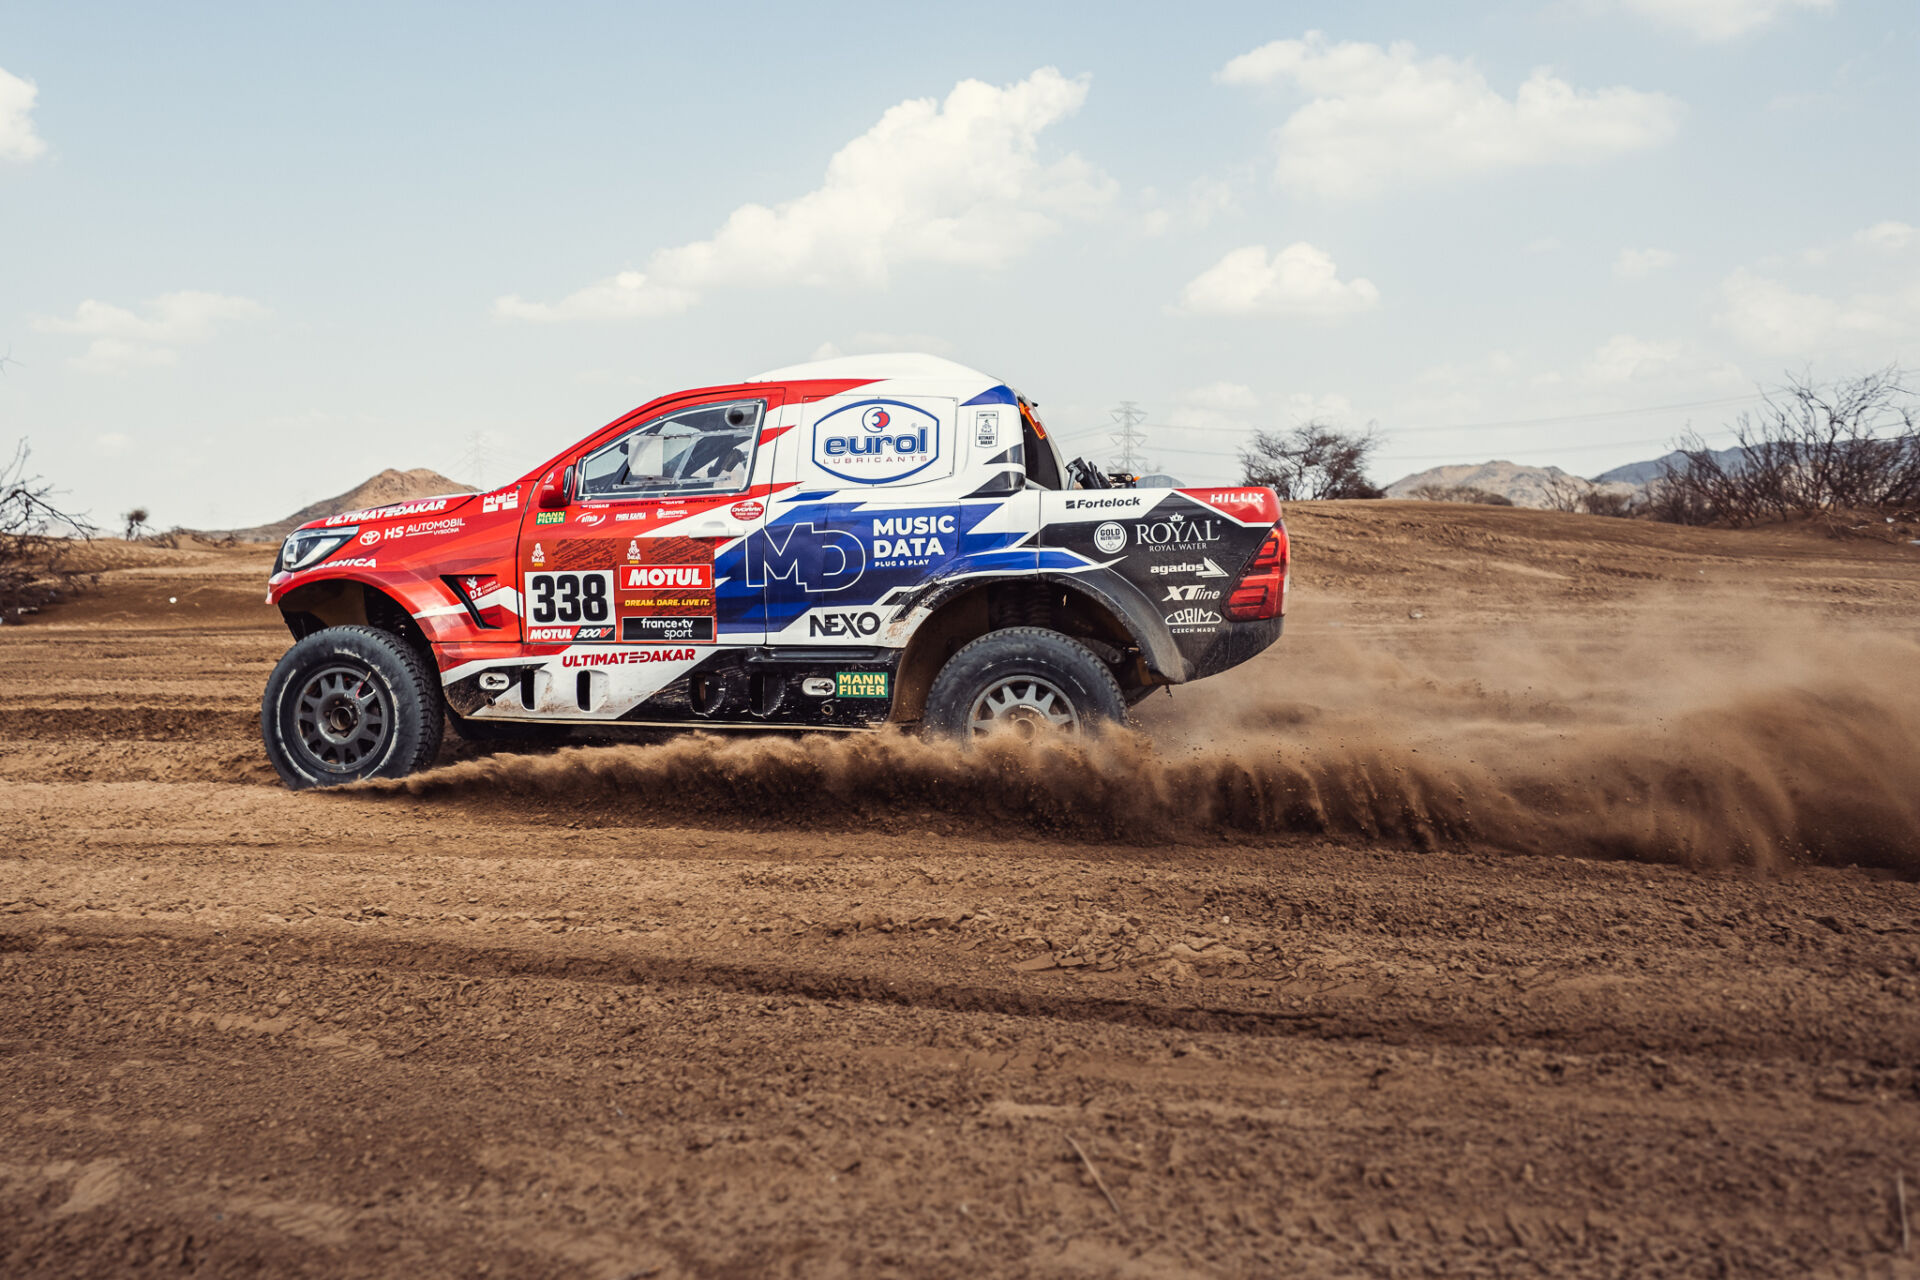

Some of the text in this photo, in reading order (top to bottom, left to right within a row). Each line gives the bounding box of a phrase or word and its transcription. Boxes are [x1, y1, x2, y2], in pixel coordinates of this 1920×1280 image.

[824, 427, 927, 456] eurol
[823, 455, 927, 464] LUBRICANTS
[1077, 497, 1140, 508] Fortelock
[1210, 493, 1264, 503] HILUX
[384, 518, 466, 540] HS AUTOMOBIL
[873, 515, 955, 537] MUSIC
[1100, 528, 1120, 536] GOLD
[1135, 520, 1220, 544] ROYAL
[873, 537, 946, 559] DATA
[1149, 542, 1208, 552] ROYAL WATER
[1150, 562, 1205, 575] agados
[628, 568, 703, 586] MOTUL
[532, 574, 608, 622] 338
[1162, 585, 1220, 601] XTline
[1174, 608, 1213, 623] PRIM
[810, 612, 880, 639] NEXO
[530, 628, 613, 640] MOTUL 300V
[664, 629, 693, 640] sport
[839, 674, 885, 685] MANN
[839, 685, 886, 696] FILTER
